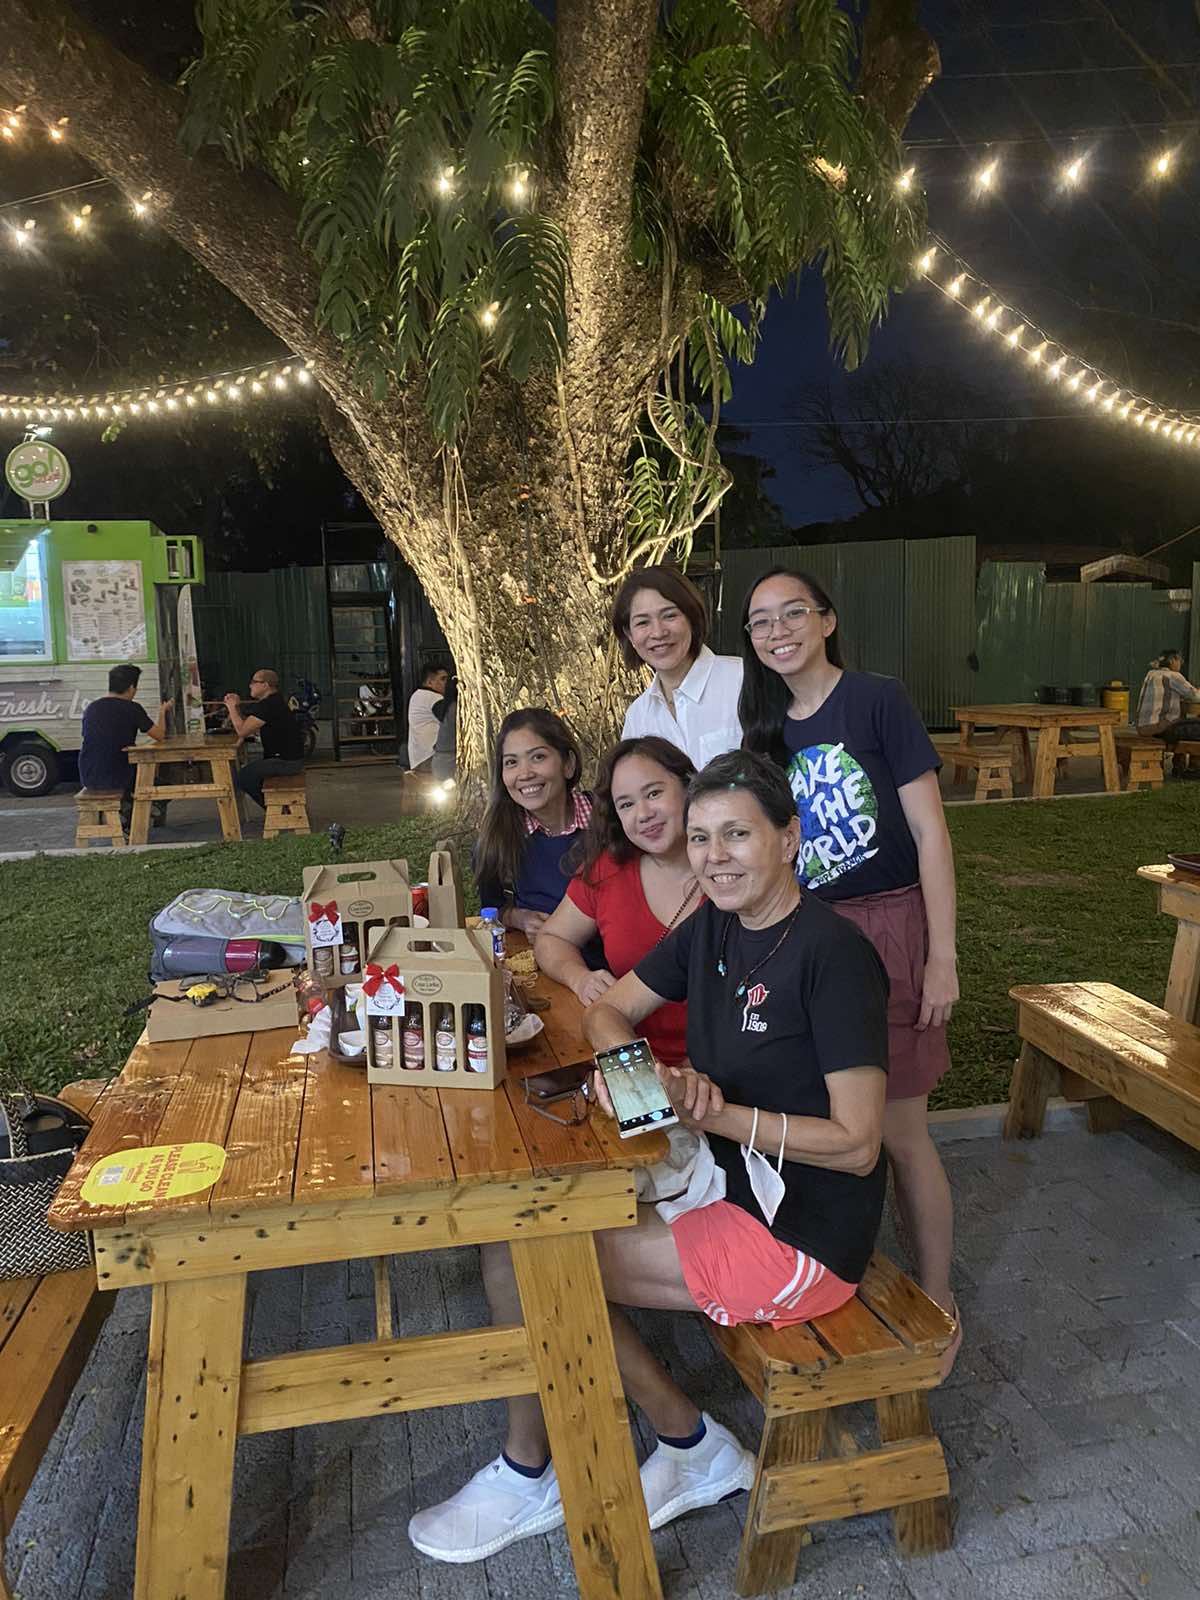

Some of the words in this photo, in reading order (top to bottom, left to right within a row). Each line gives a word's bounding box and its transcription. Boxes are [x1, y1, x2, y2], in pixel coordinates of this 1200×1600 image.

[788, 742, 844, 800] AKE
[810, 770, 865, 830] THE
[163, 1146, 185, 1172] PLEASE
[139, 1180, 155, 1193] GO
[153, 1172, 174, 1199] CLEAN
